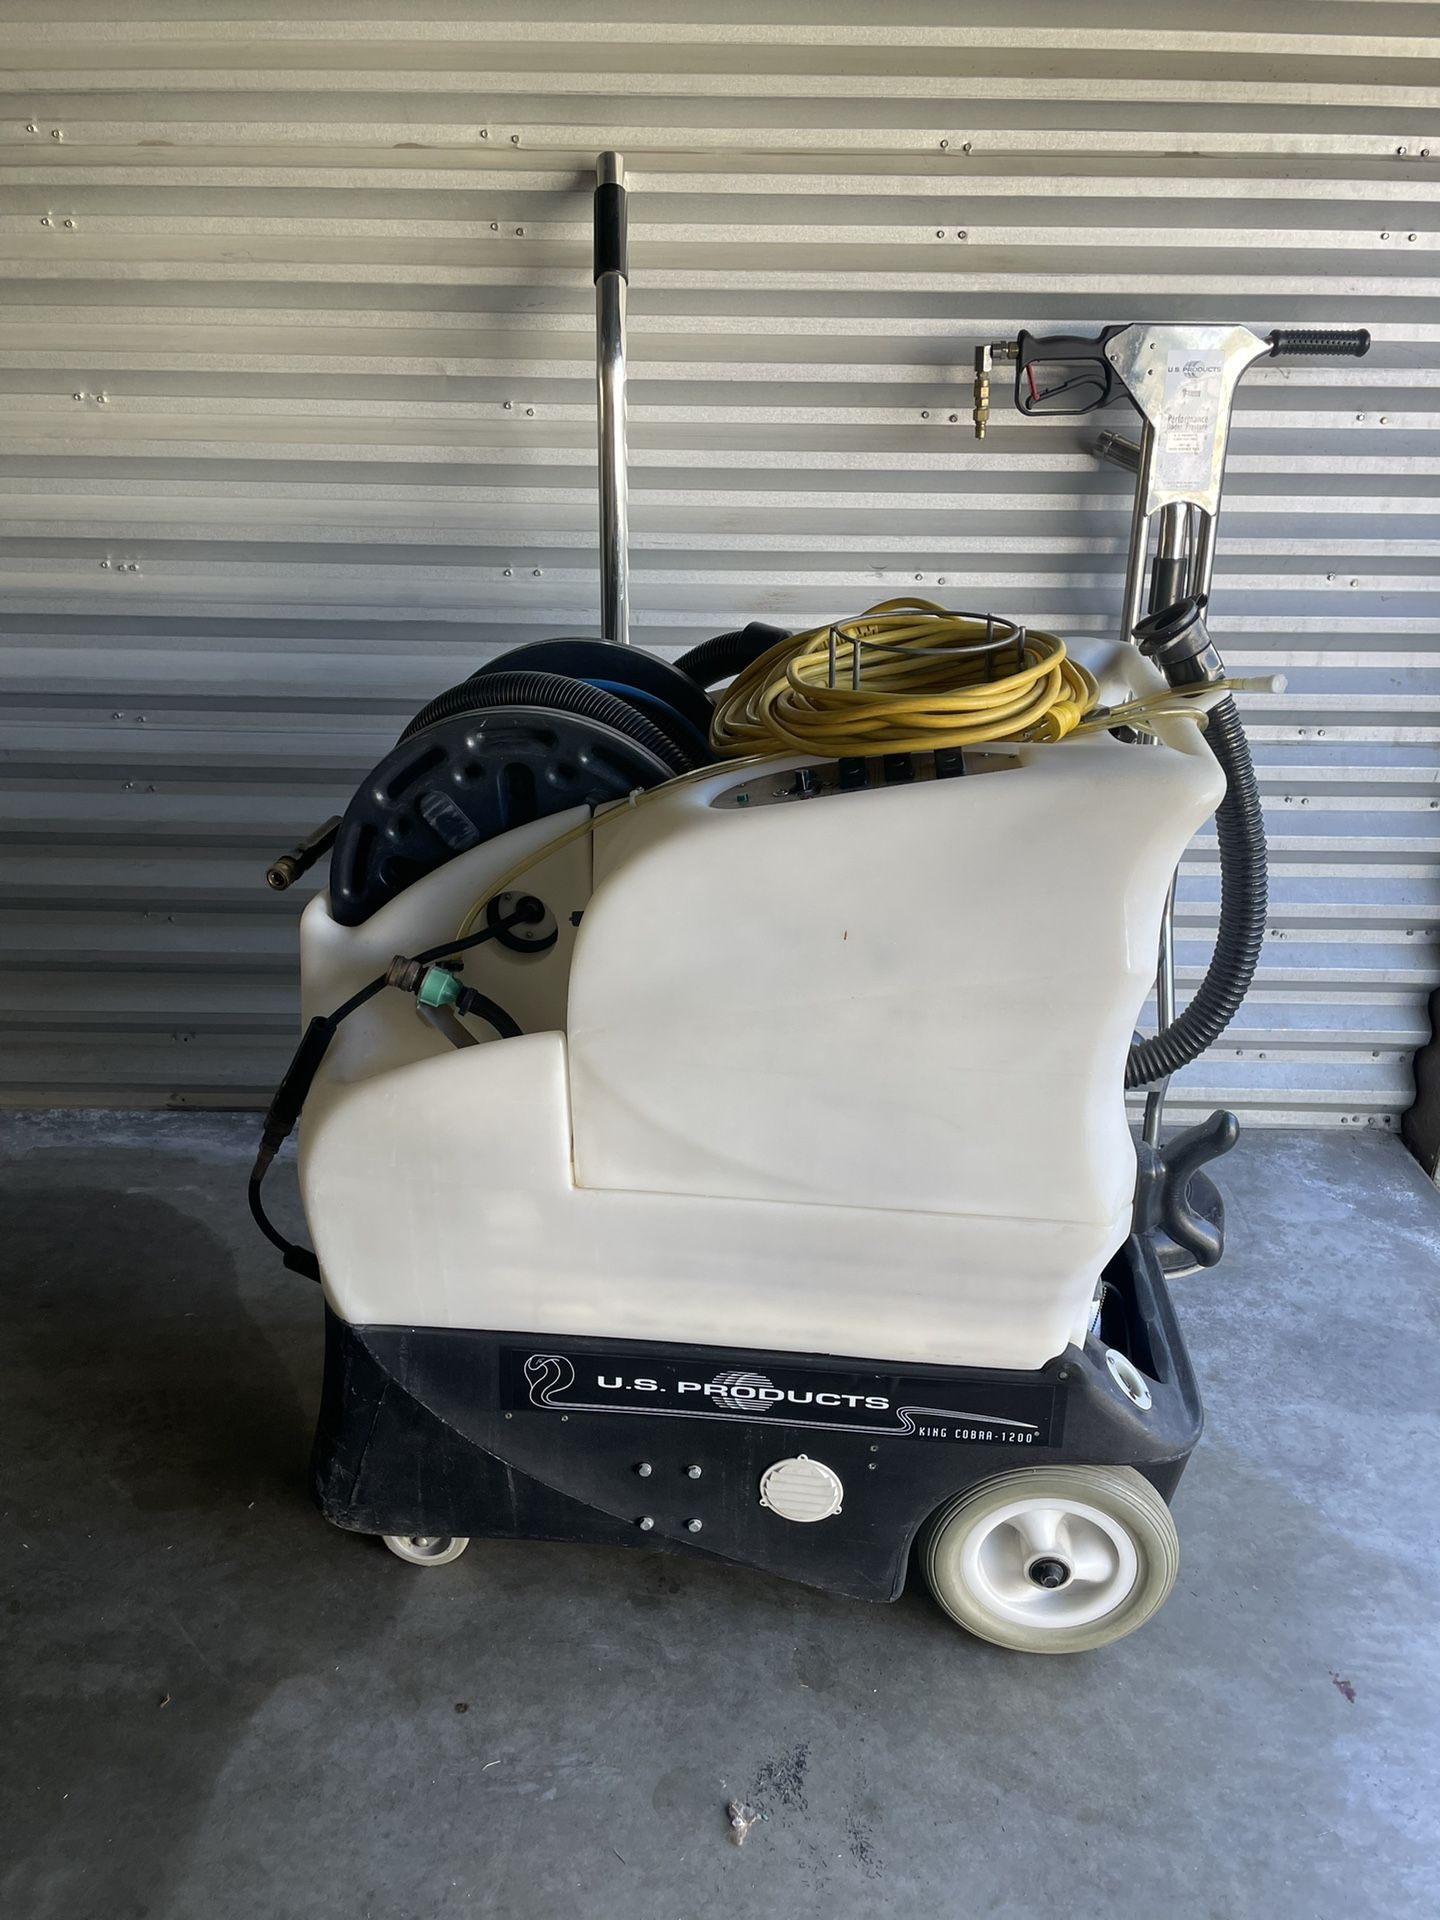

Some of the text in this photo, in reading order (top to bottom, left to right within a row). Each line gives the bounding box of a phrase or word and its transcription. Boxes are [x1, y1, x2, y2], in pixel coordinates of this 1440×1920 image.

[597, 1375, 890, 1411] U.S. PRODUCTS
[919, 1426, 947, 1438] KING
